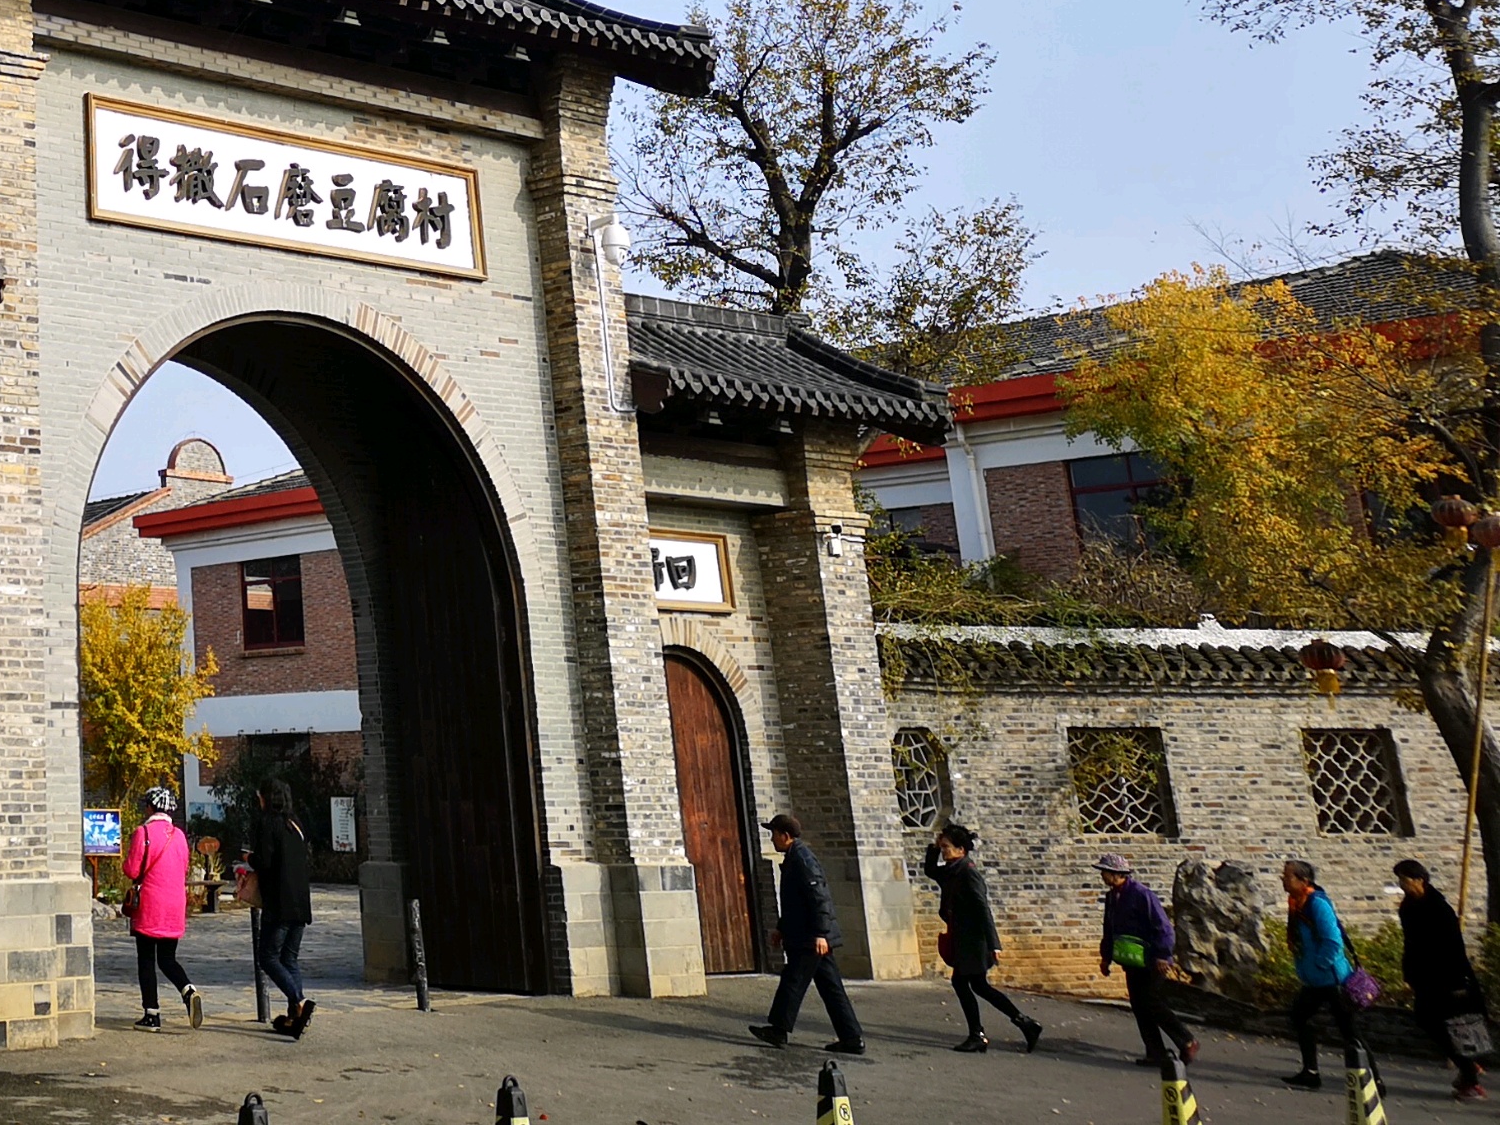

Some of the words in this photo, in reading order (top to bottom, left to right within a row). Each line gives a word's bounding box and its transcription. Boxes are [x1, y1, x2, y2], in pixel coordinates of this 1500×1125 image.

[113, 133, 455, 249] 得撒石磨豆腐村
